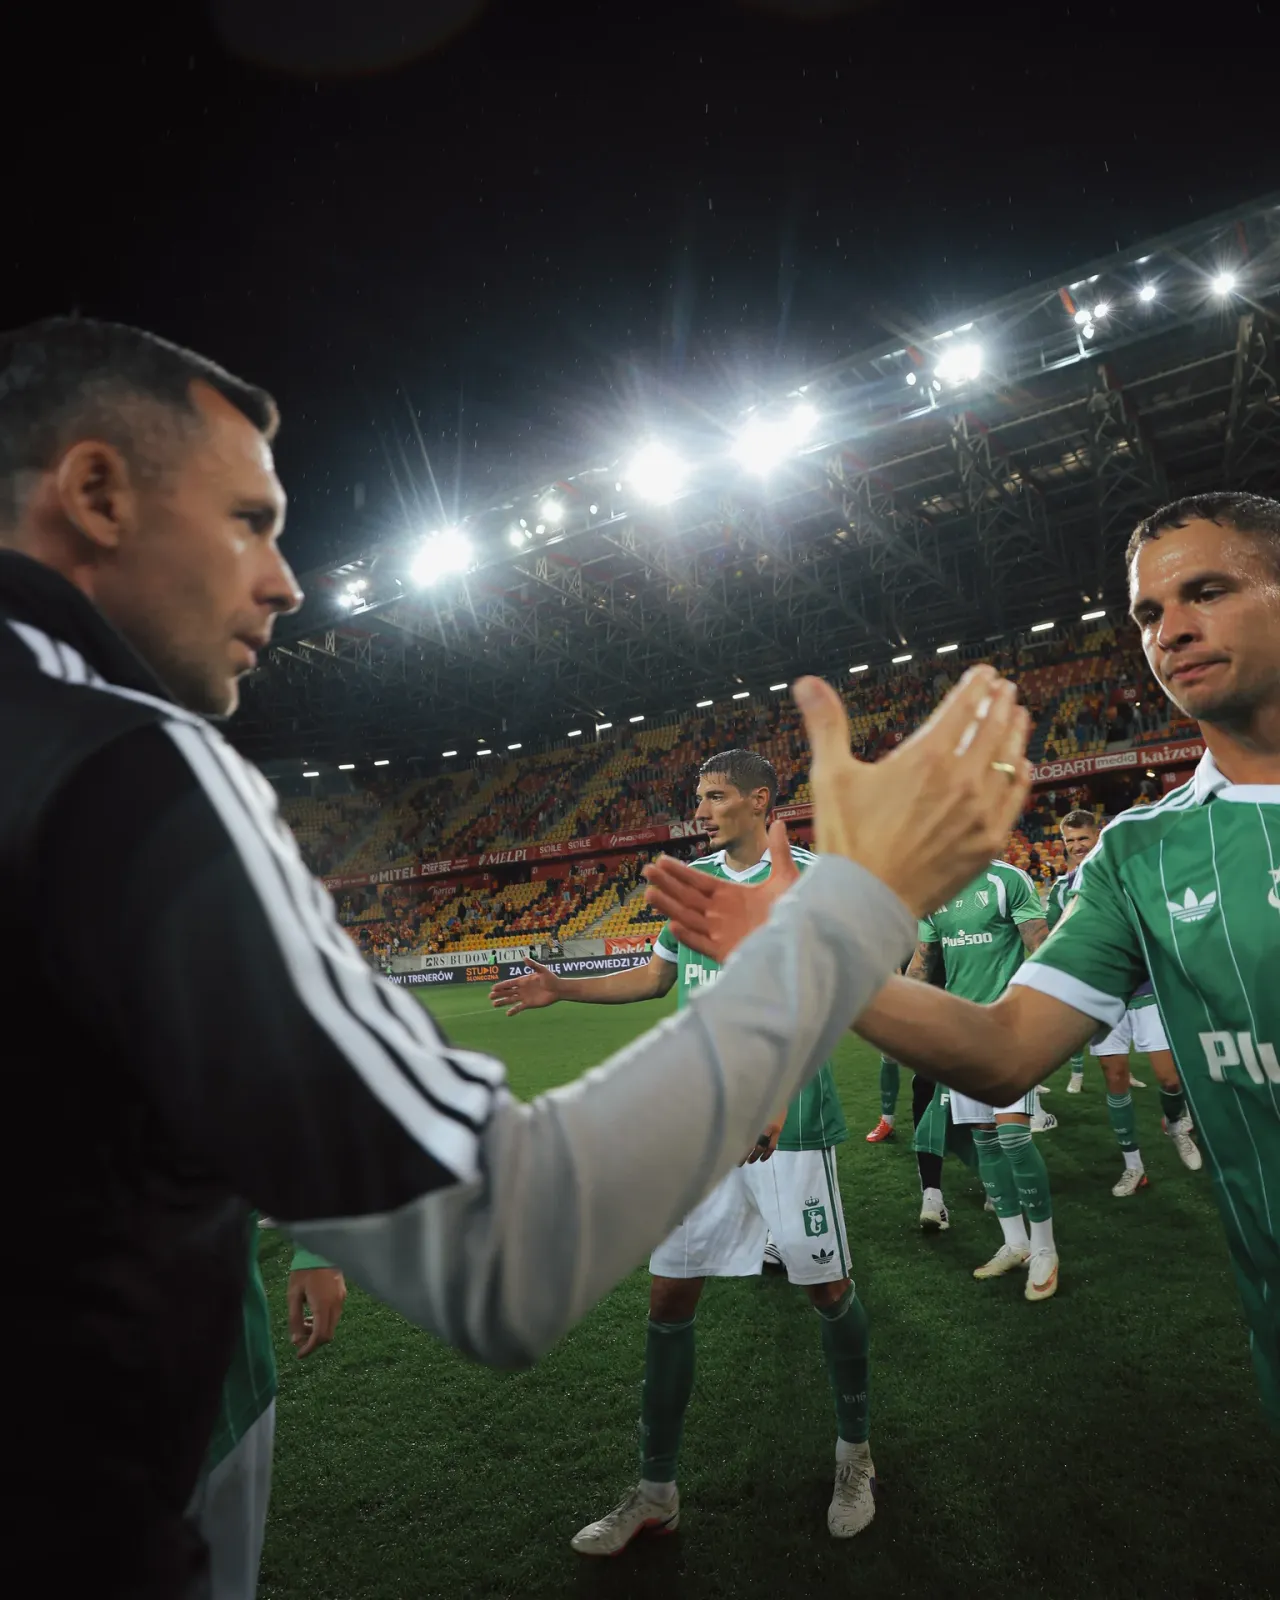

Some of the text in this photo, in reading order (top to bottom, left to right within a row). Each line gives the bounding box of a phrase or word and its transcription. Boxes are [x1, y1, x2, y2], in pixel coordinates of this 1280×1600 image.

[1097, 753, 1136, 767] media
[1141, 745, 1203, 764] kaizen
[486, 849, 527, 865] MELPI
[379, 867, 417, 882] MITEL
[955, 900, 963, 908] 27
[942, 930, 993, 948] Plus500
[509, 966, 522, 976] ZA
[563, 958, 630, 972] WYPOWIEDZI
[408, 970, 454, 984] TRENERÓW
